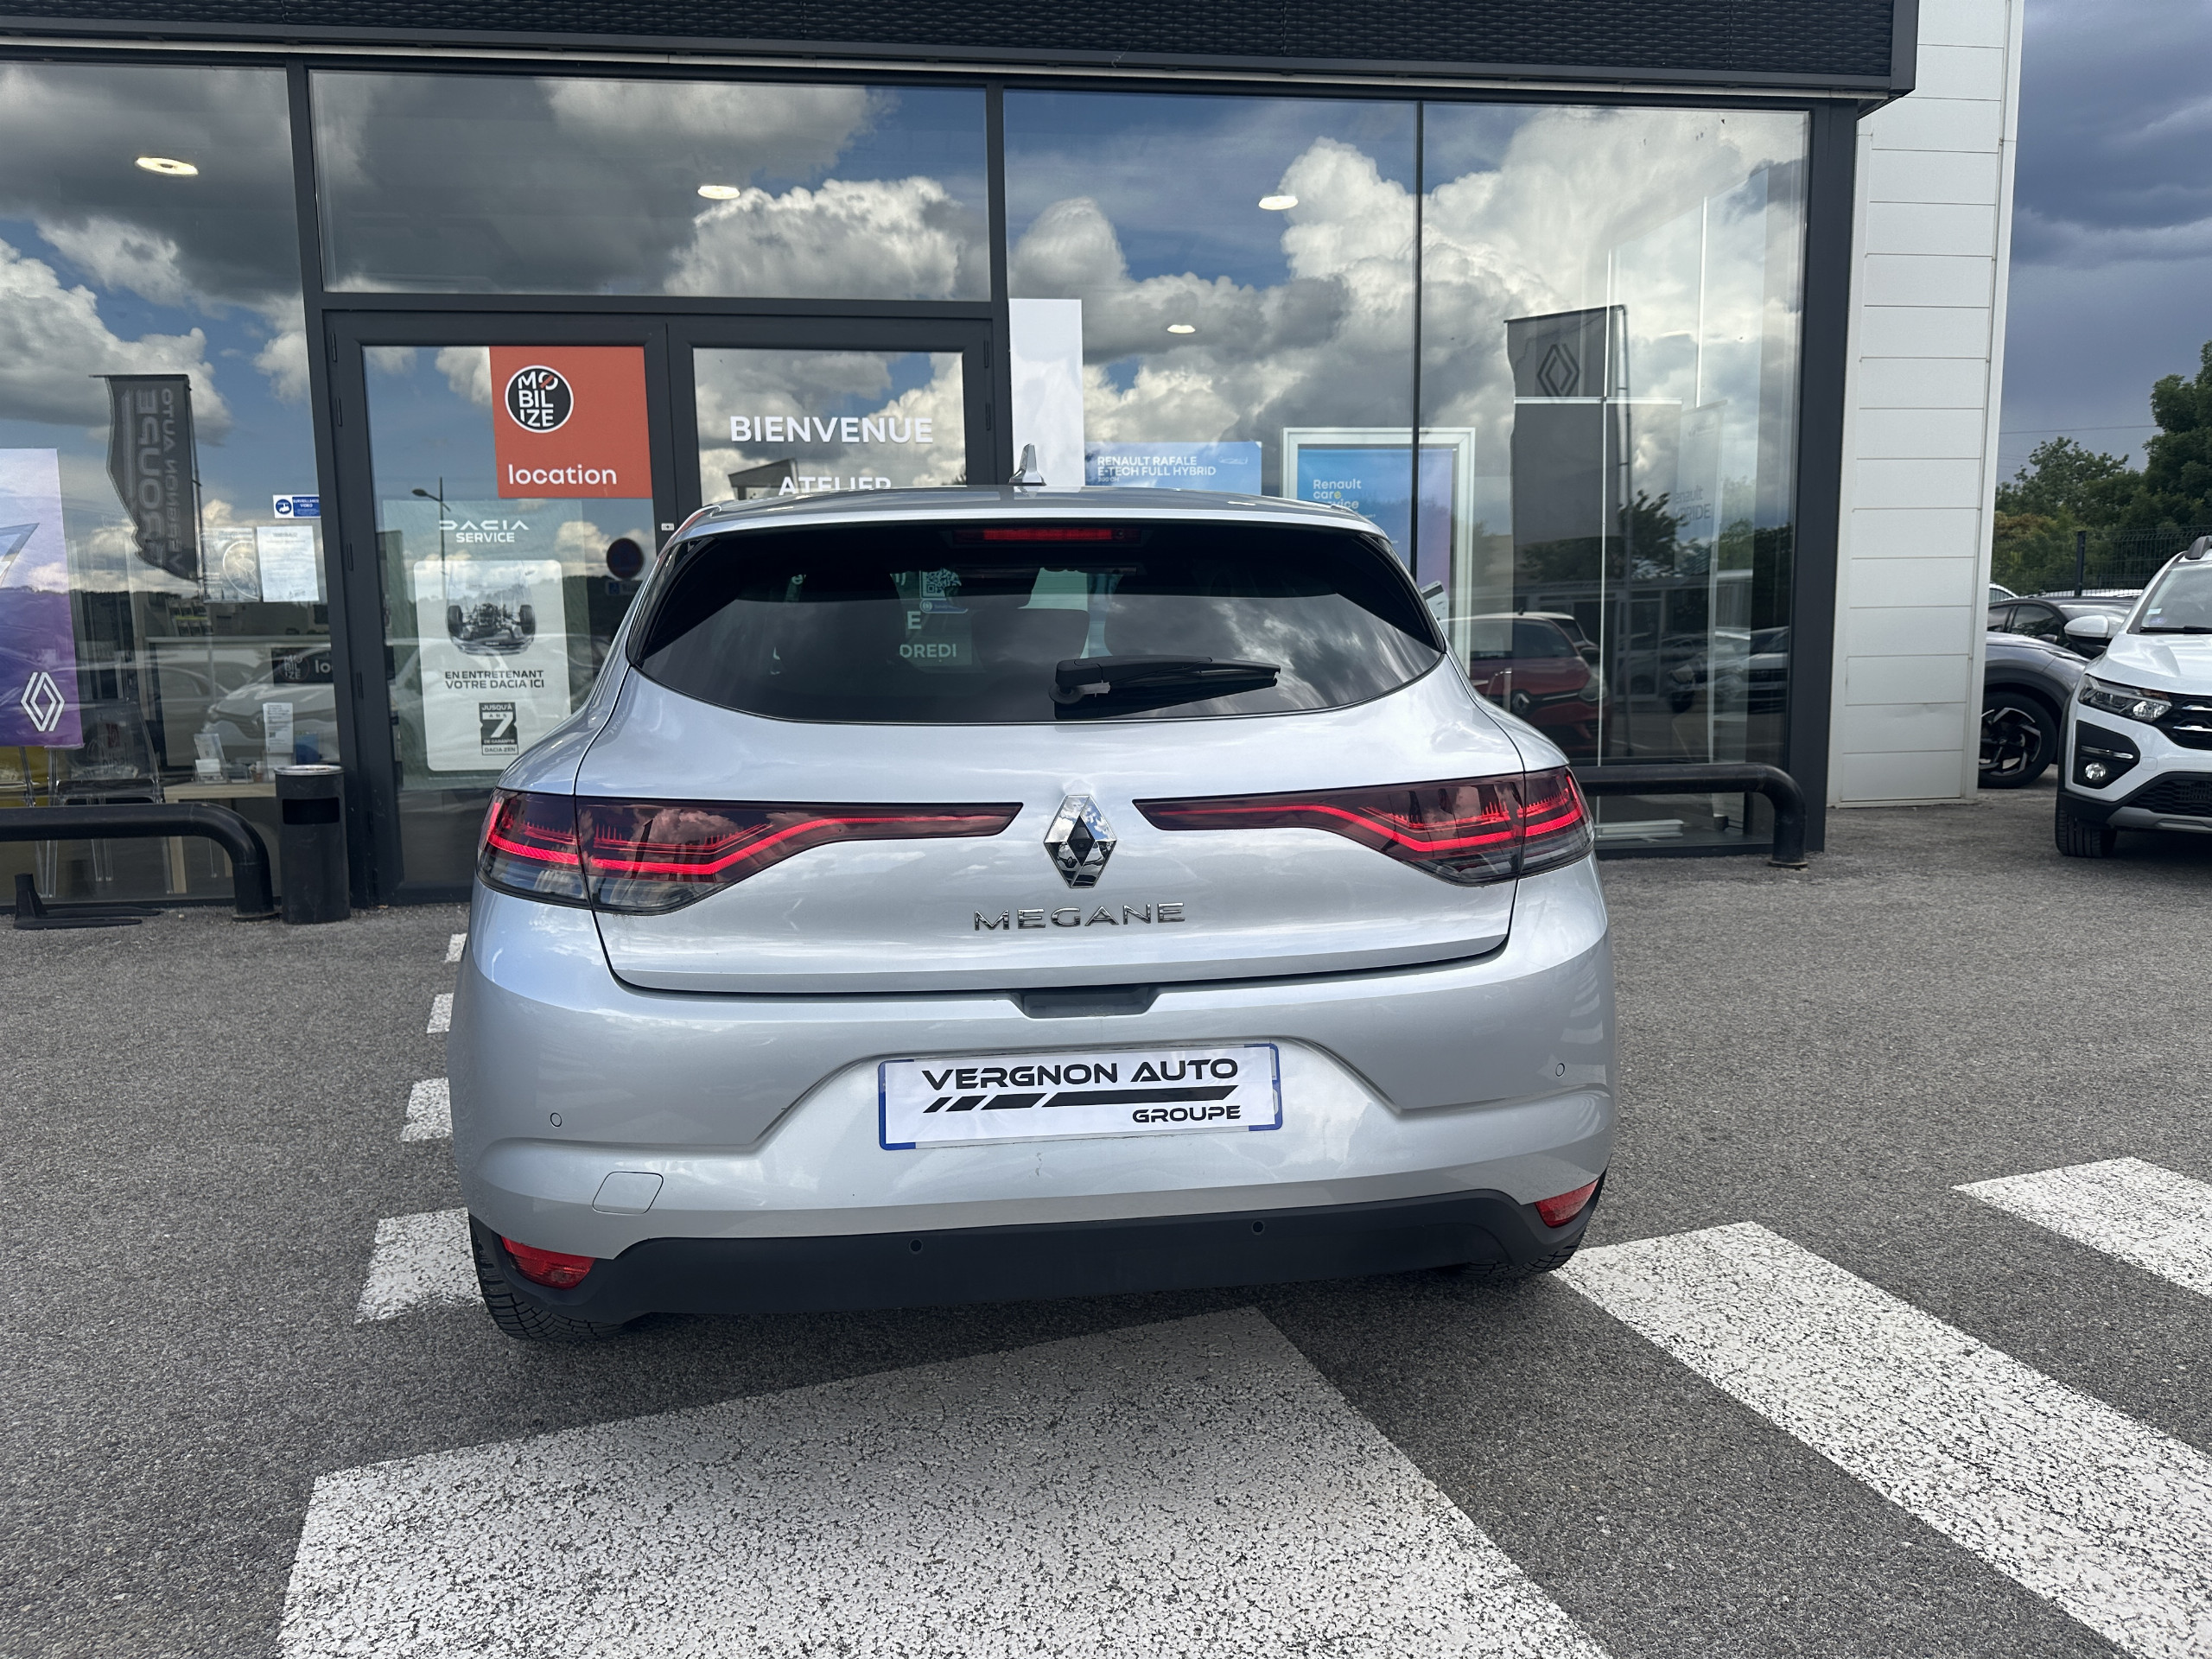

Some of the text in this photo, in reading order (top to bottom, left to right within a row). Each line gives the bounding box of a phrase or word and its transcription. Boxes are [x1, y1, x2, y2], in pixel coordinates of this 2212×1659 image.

[730, 416, 933, 443] BIENVENUE
[1097, 456, 1197, 466] RENAULT RAFALE
[508, 464, 617, 485] location
[1097, 467, 1217, 476] E-TECH FULL HYBRID
[1313, 479, 1362, 489] Renault
[1313, 491, 1341, 499] care
[439, 520, 530, 531] DACIA
[456, 532, 515, 543] SERVICE
[462, 671, 543, 679] ENTRETENANT
[446, 679, 544, 689] VOTRE DACIA ICI
[482, 711, 513, 738] 7
[974, 901, 1185, 931] MEGANE
[921, 1058, 1238, 1091] VERGNON AUTO
[1132, 1105, 1241, 1123] GROUPE
